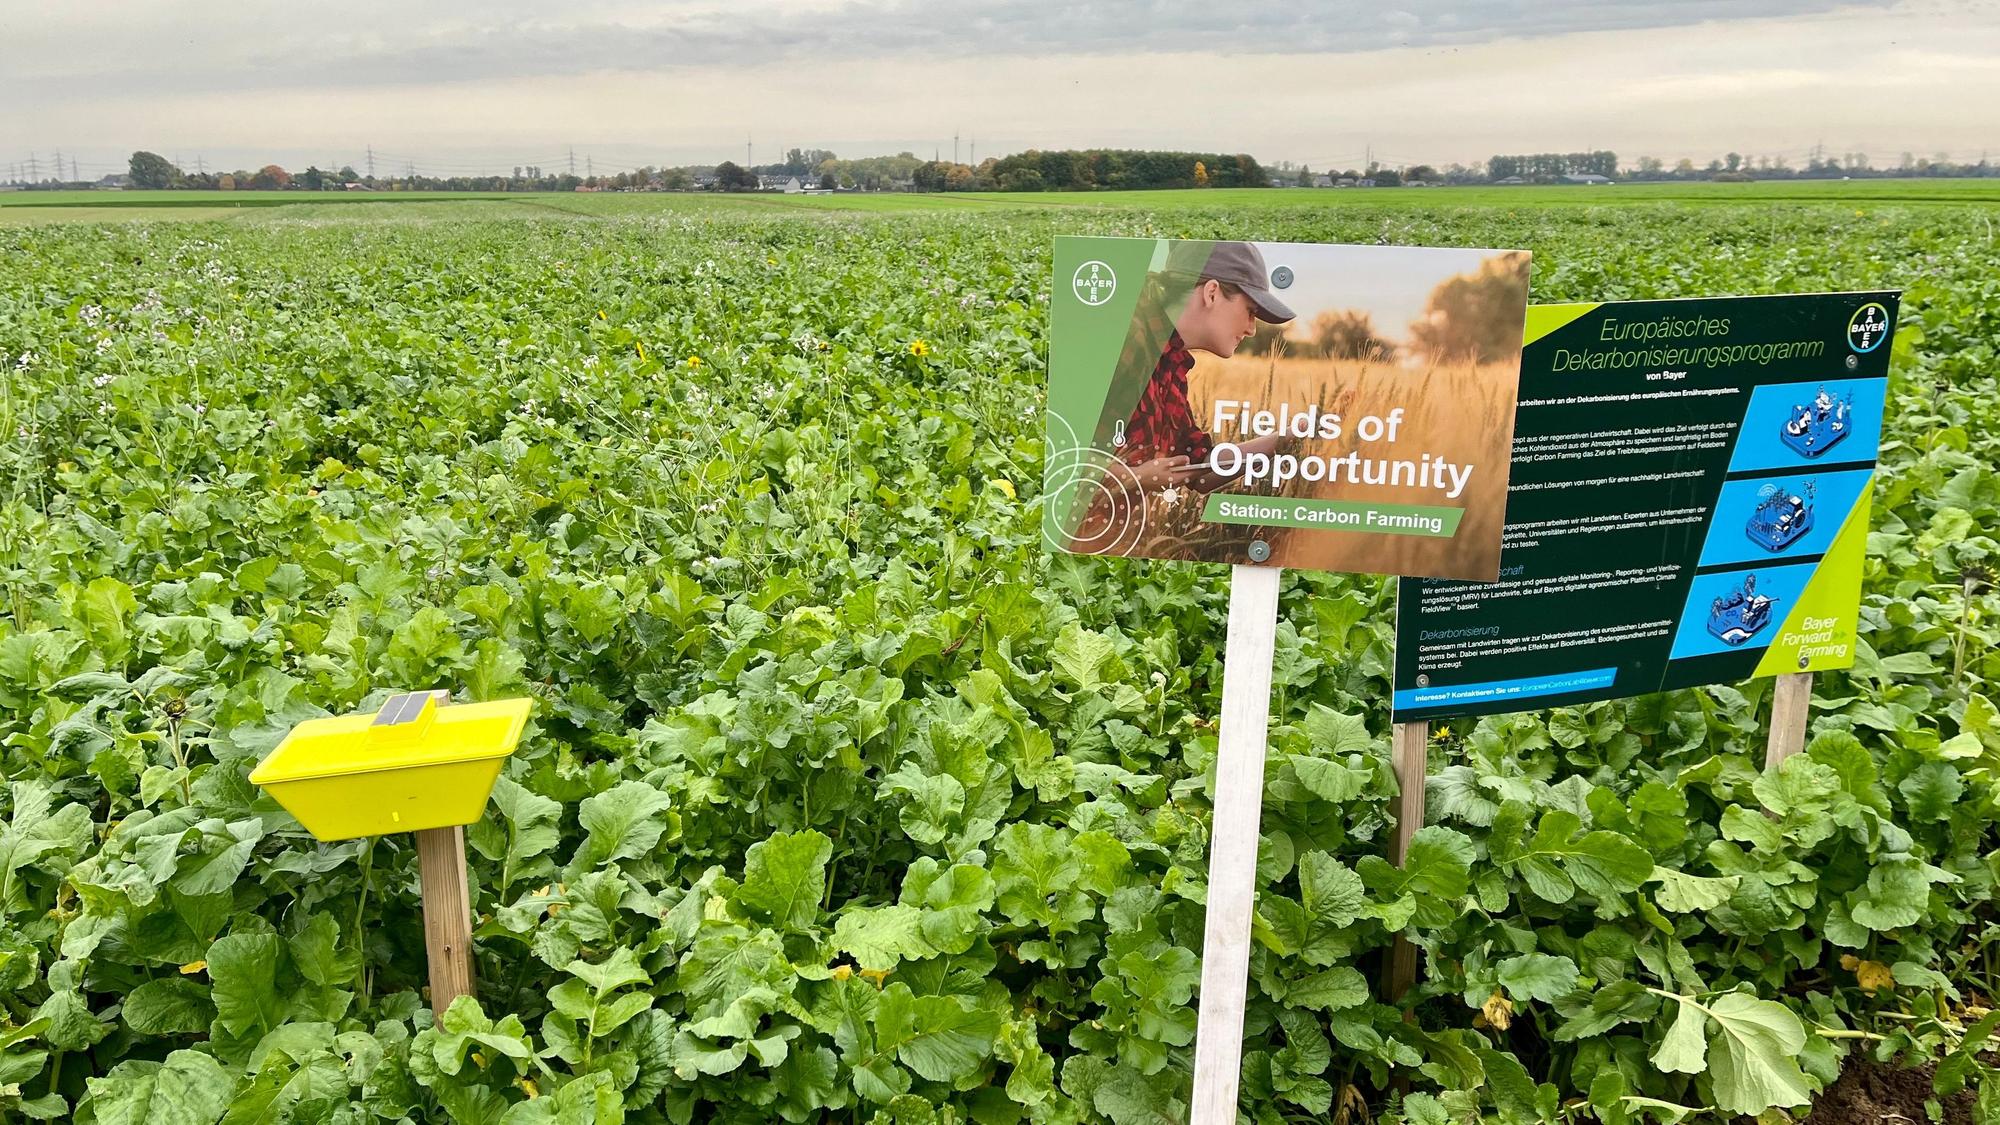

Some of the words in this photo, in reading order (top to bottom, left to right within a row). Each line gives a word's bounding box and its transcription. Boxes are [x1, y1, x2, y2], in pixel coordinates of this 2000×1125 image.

[1076, 279, 1112, 287] BAYER
[1090, 264, 1098, 302] BAYER
[1600, 315, 1730, 343] Europäisches
[1852, 322, 1885, 332] BAYER
[1861, 307, 1875, 348] BAYER
[1552, 340, 1824, 371] Dekarbonisierungsprogramm
[1646, 372, 1662, 380] von
[1662, 370, 1686, 381] Bayer
[1577, 394, 1630, 403] Dekarbonisierung
[1642, 390, 1682, 399] europäischen
[1213, 400, 1341, 439] Fields
[1357, 408, 1404, 442] of
[1528, 443, 1568, 452] Kohlendioxid
[1590, 439, 1626, 447] Atmosphäre
[1634, 437, 1662, 445] speichern
[1674, 434, 1702, 442] langfristig
[1550, 433, 1589, 442] regenerativen
[1590, 429, 1633, 438] Landwirtschaft.
[1210, 442, 1474, 498] Opportunity
[1218, 502, 1288, 520] Station:
[1294, 506, 1360, 524] Carbon
[1366, 510, 1442, 532] Farming
[1660, 508, 1696, 516] Unternehmen
[1528, 529, 1566, 537] Universitäten
[1580, 524, 1616, 534] Regierungen
[1421, 596, 1460, 605] rungslösung
[1460, 593, 1480, 602] (MRV)
[1490, 590, 1522, 598] Landwirte,
[1533, 586, 1543, 594] auf
[1564, 583, 1588, 592] digitaler
[1588, 578, 1629, 589] agronomischer
[1434, 585, 1468, 594] entwickeln
[1484, 580, 1521, 590] zuverlässige
[1534, 578, 1557, 586] genaue
[1558, 574, 1580, 583] digitale
[1802, 616, 1839, 632] Bayer
[1419, 626, 1500, 640] Dekarbonisierung
[1419, 644, 1456, 652] Gemeinsam
[1467, 640, 1501, 648] Landwirten
[1541, 630, 1590, 640] Dekarbonisierung
[1601, 624, 1638, 633] europäischen
[1782, 629, 1832, 646] Forward
[1418, 654, 1446, 662] systems
[1503, 645, 1528, 654] positive
[1598, 631, 1646, 643] Bodengesundheit
[1797, 642, 1848, 658] Farming
[1415, 692, 1450, 701] Interesse?
[1451, 690, 1495, 698] Kontaktieren
